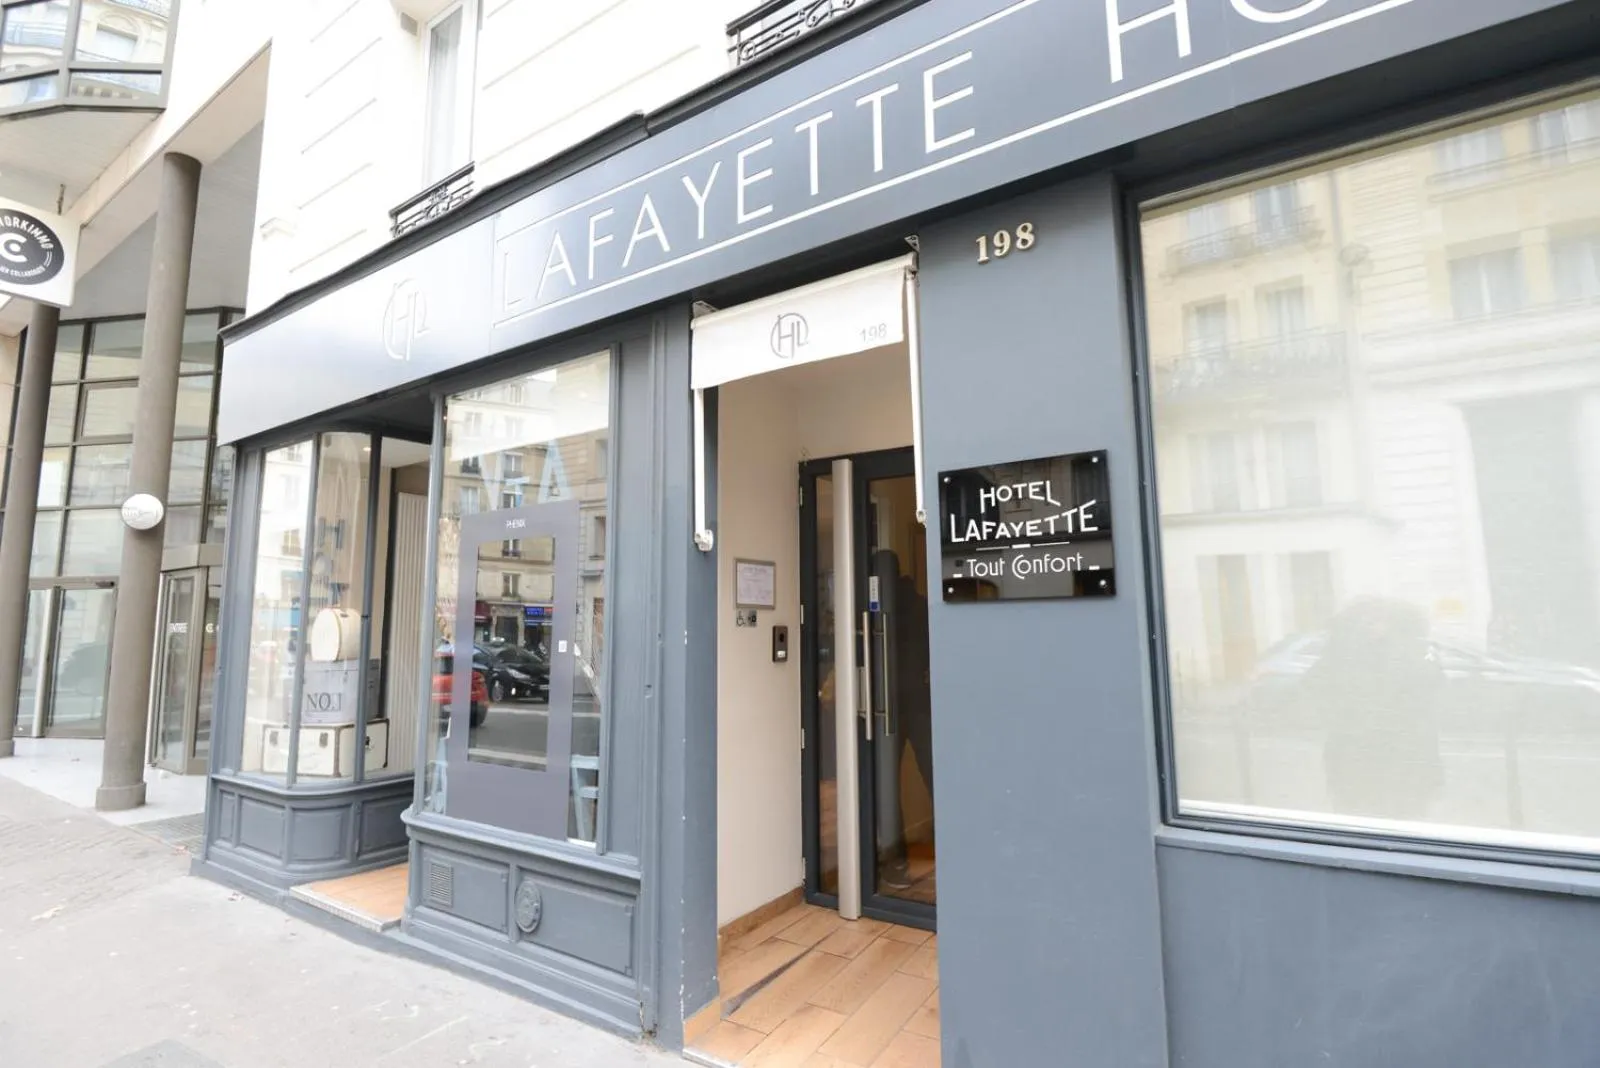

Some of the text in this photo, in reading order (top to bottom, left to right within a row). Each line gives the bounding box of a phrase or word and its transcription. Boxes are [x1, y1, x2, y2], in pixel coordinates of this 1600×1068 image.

[503, 0, 1330, 307] LAFAYETTE H
[976, 222, 1035, 263] 198
[859, 323, 888, 344] 198
[979, 480, 1061, 514] HOTEL
[950, 499, 1098, 542] LAFAYETTE
[966, 552, 1084, 579] Tout Confort
